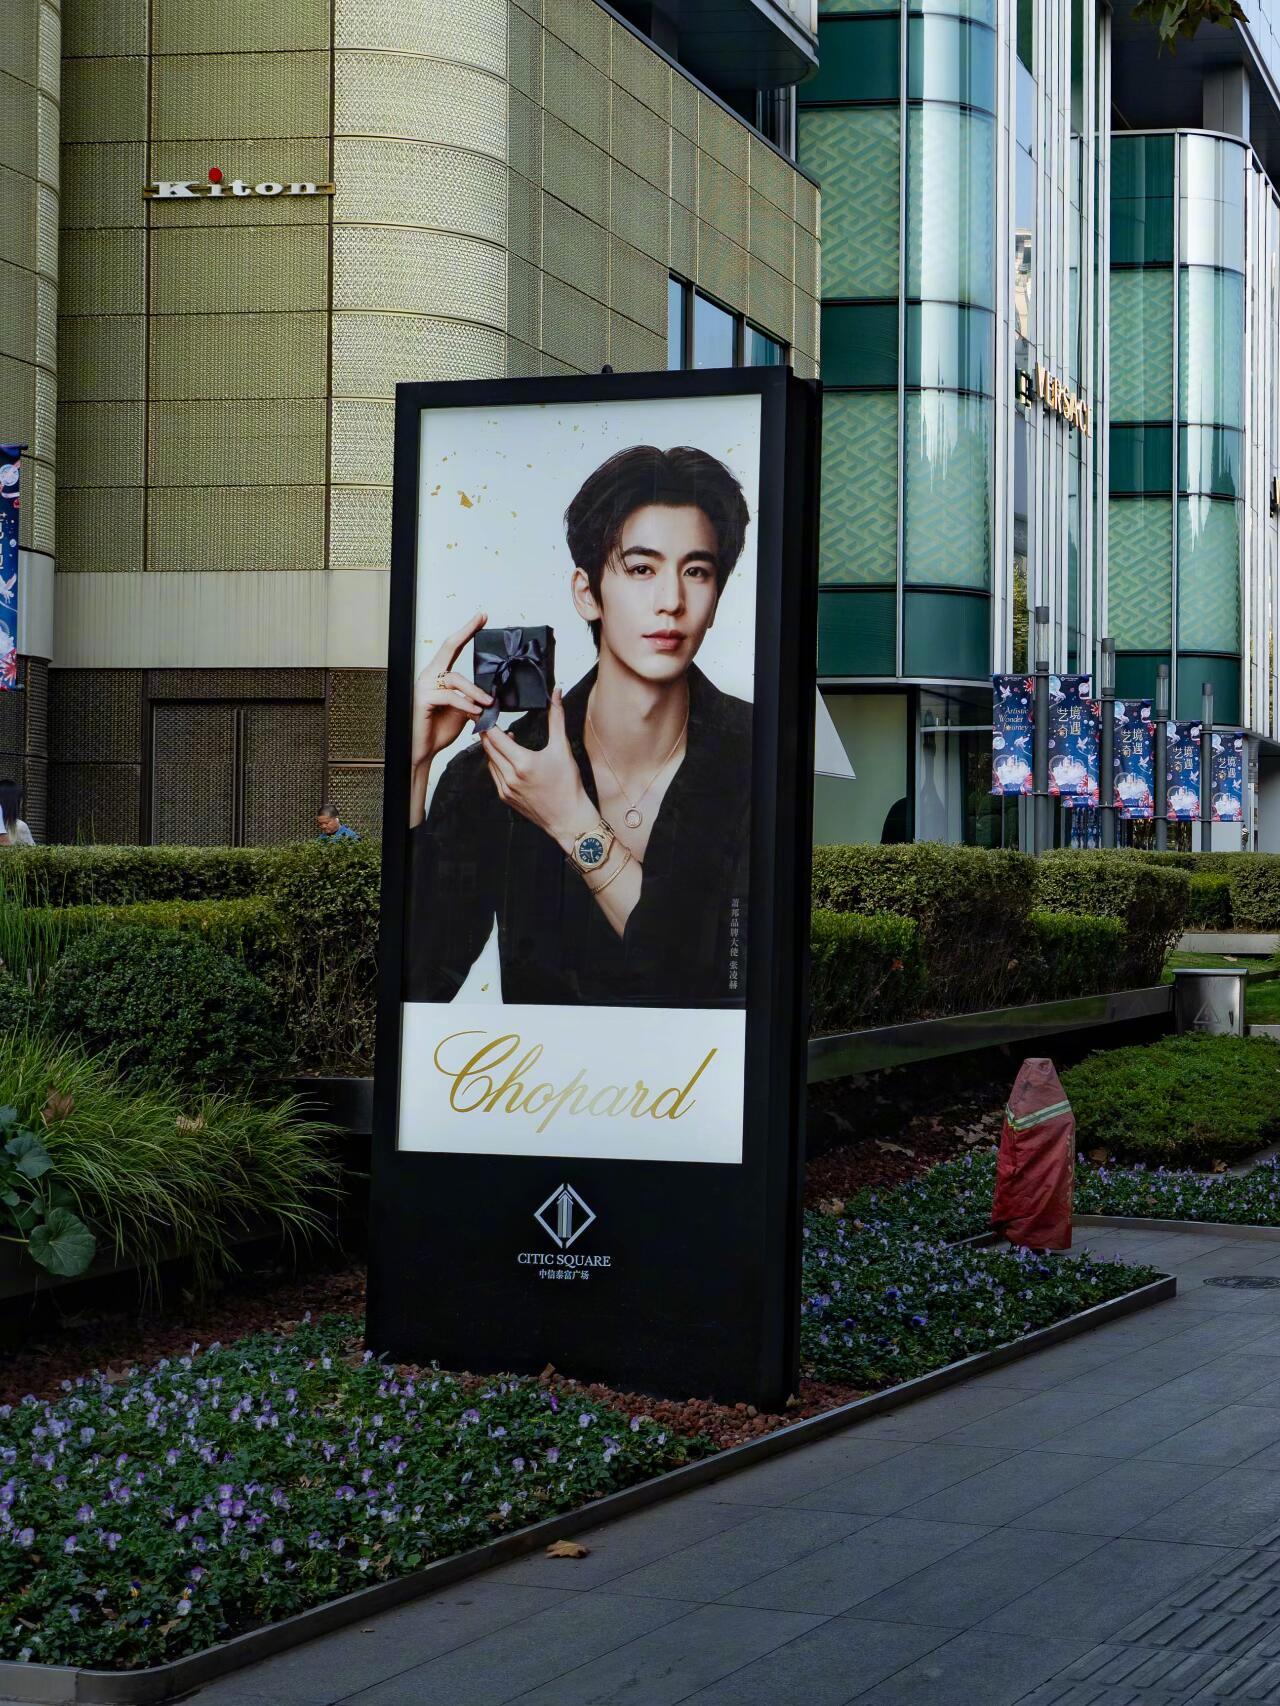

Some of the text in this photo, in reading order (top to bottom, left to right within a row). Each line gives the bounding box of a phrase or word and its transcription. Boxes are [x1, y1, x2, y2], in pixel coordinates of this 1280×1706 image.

[152, 167, 320, 198] Kiton
[1005, 706, 1028, 715] Artistic
[999, 714, 1024, 723] Wonder
[1003, 723, 1029, 733] Journey
[434, 1030, 718, 1134] Chopard
[517, 1253, 612, 1269] CITIC SQUARE
[539, 1268, 590, 1280] 中信泰富广场
